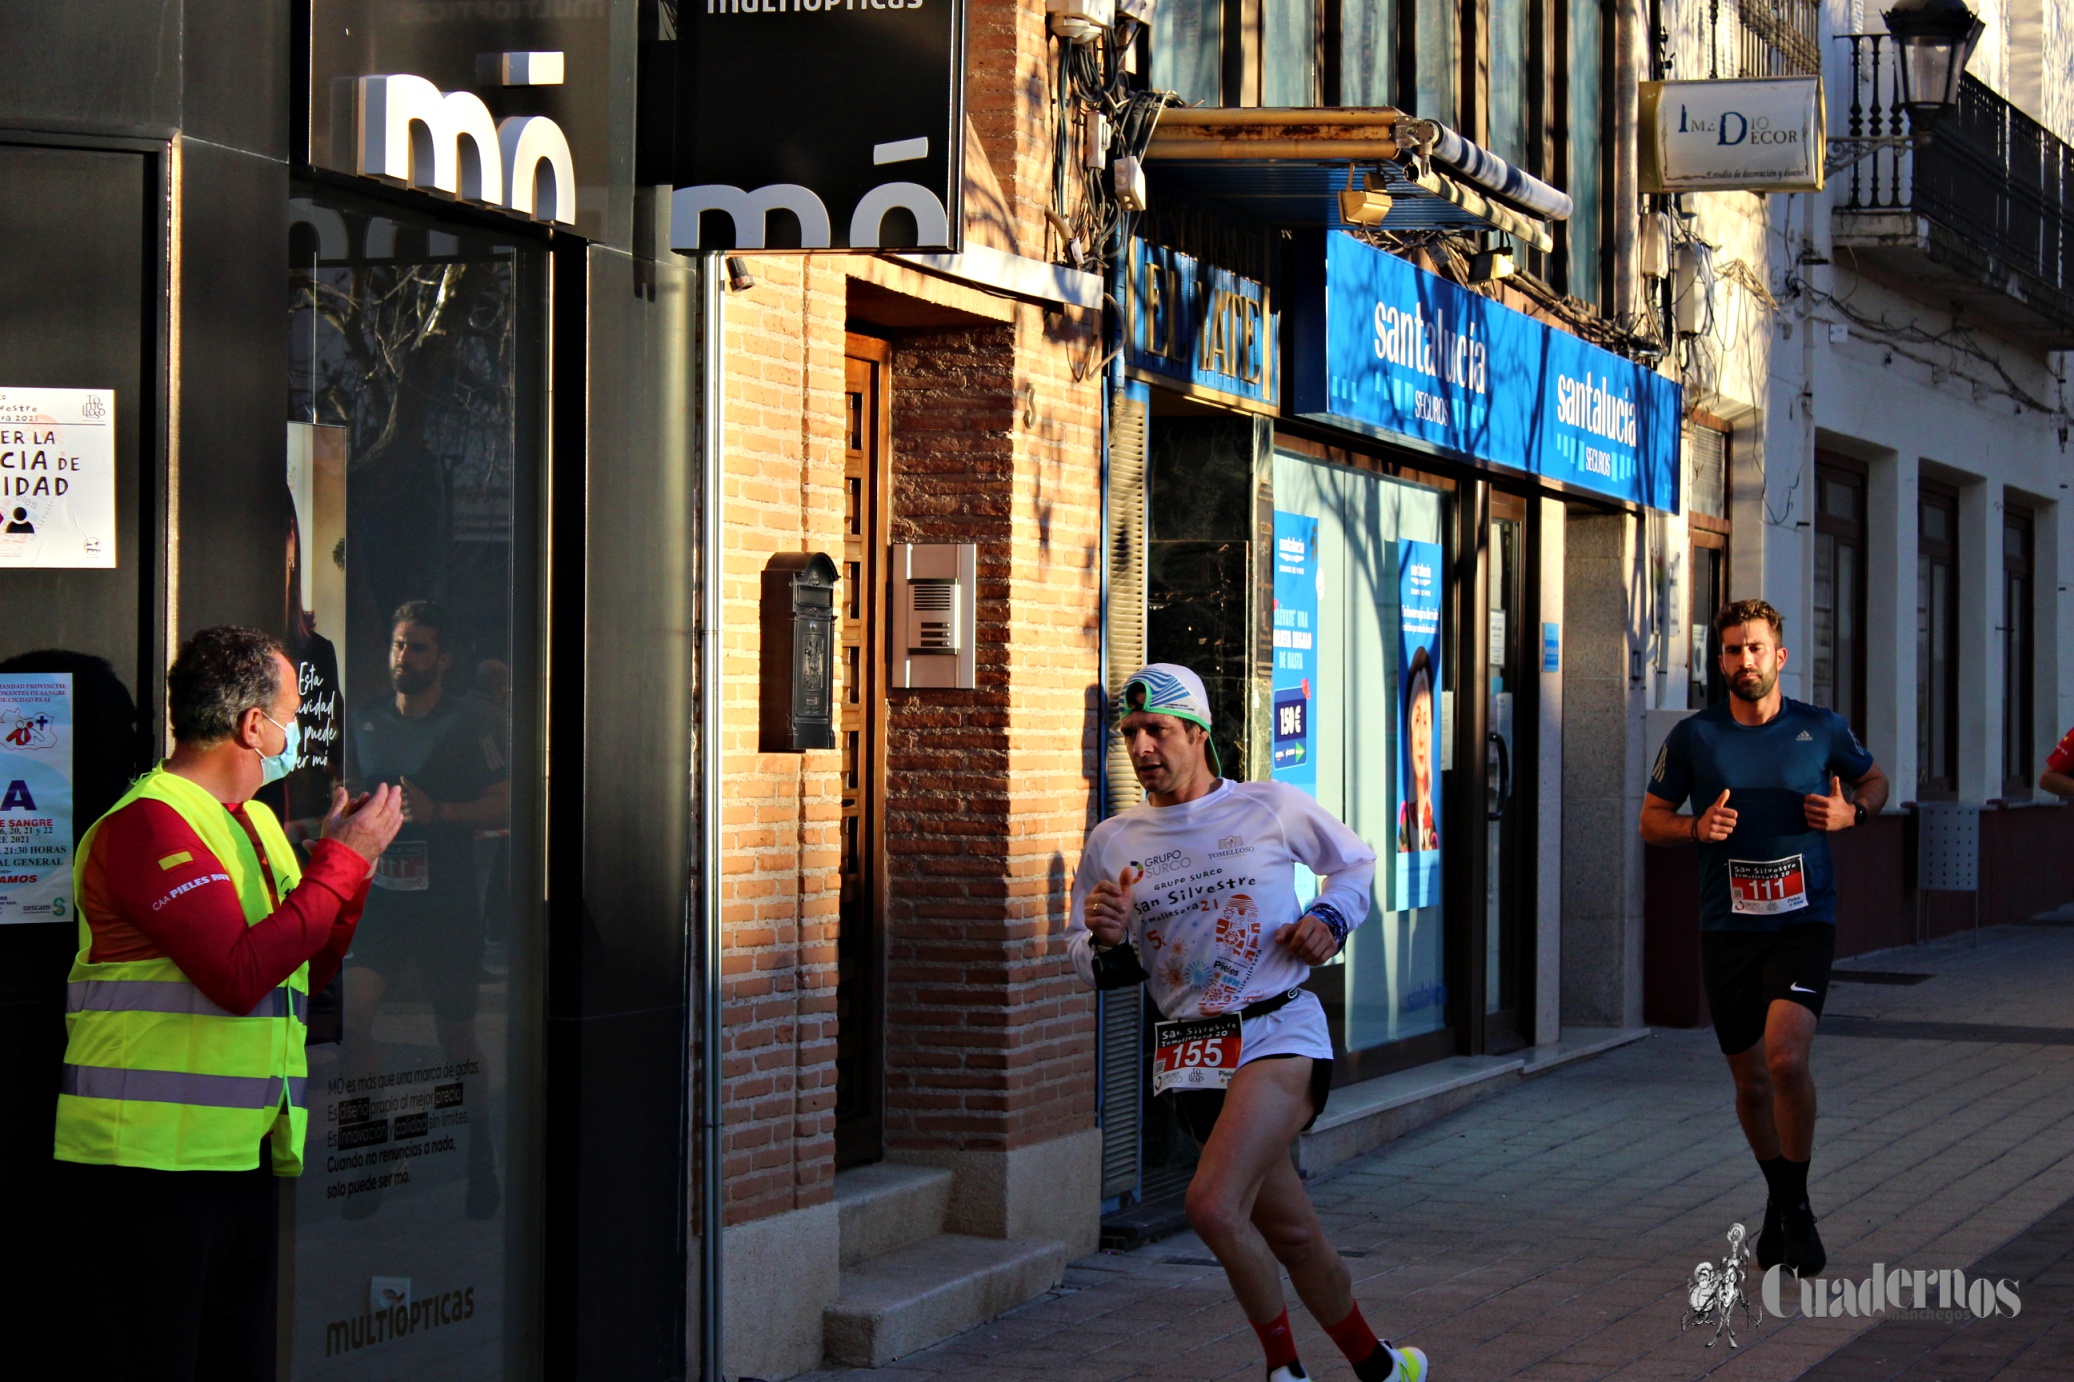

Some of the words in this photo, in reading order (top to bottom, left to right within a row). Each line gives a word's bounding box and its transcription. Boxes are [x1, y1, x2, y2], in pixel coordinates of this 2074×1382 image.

[1706, 172, 1732, 180] Estudio
[1733, 171, 1742, 179] de
[1778, 170, 1783, 181] y
[1374, 301, 1487, 395] santalucía
[1414, 389, 1450, 427] SEGUROS
[1556, 371, 1638, 448] santalucía
[1, 430, 25, 445] ER
[33, 430, 56, 445] LA
[0, 450, 48, 470] CIA
[58, 457, 81, 471] DE
[1585, 446, 1611, 477] SEGUROS
[4, 475, 69, 496] IDAD
[298, 661, 323, 696] Esta
[304, 717, 336, 753] puede
[0, 780, 37, 811] A
[8, 818, 53, 828] SANGRE
[24, 826, 33, 835] 21
[36, 828, 41, 836] y
[43, 826, 53, 834] 22
[4, 846, 28, 855] 21:30
[30, 845, 67, 854] HORAS
[10, 835, 29, 844] 2021
[1208, 845, 1255, 860] TOMELLOSO
[13, 857, 63, 867] GENERAL
[1144, 849, 1182, 868] GRUPO
[1145, 856, 1192, 879] SURCO
[1154, 877, 1186, 891] GRUPO
[1190, 867, 1223, 882] SURCO
[1749, 878, 1785, 900] 111
[152, 895, 171, 911] CAA
[169, 875, 210, 899] PIELES
[1134, 898, 1161, 916] San
[1168, 876, 1257, 905] Silvestre
[1213, 960, 1240, 977] Pieles
[1173, 1038, 1223, 1069] 155
[346, 1079, 356, 1094] es
[358, 1072, 376, 1091] más
[378, 1073, 395, 1091] que
[397, 1070, 412, 1086] una
[414, 1067, 441, 1082] marca
[442, 1060, 454, 1077] de
[328, 1104, 337, 1122] Es
[339, 1099, 369, 1120] diseño
[370, 1095, 398, 1119] propio
[400, 1093, 408, 1109] al
[410, 1088, 435, 1112] mejor
[328, 1130, 337, 1147] Es
[338, 1121, 387, 1146] innovación
[388, 1125, 395, 1142] y
[395, 1115, 428, 1135] calidad
[428, 1112, 440, 1130] sin
[327, 1151, 364, 1173] Cuando
[365, 1153, 377, 1167] no
[379, 1141, 422, 1163] renuncias
[424, 1141, 430, 1155] a
[431, 1134, 456, 1153] nada,
[327, 1179, 346, 1199] solo
[347, 1174, 377, 1200] puede
[378, 1172, 393, 1188] ser
